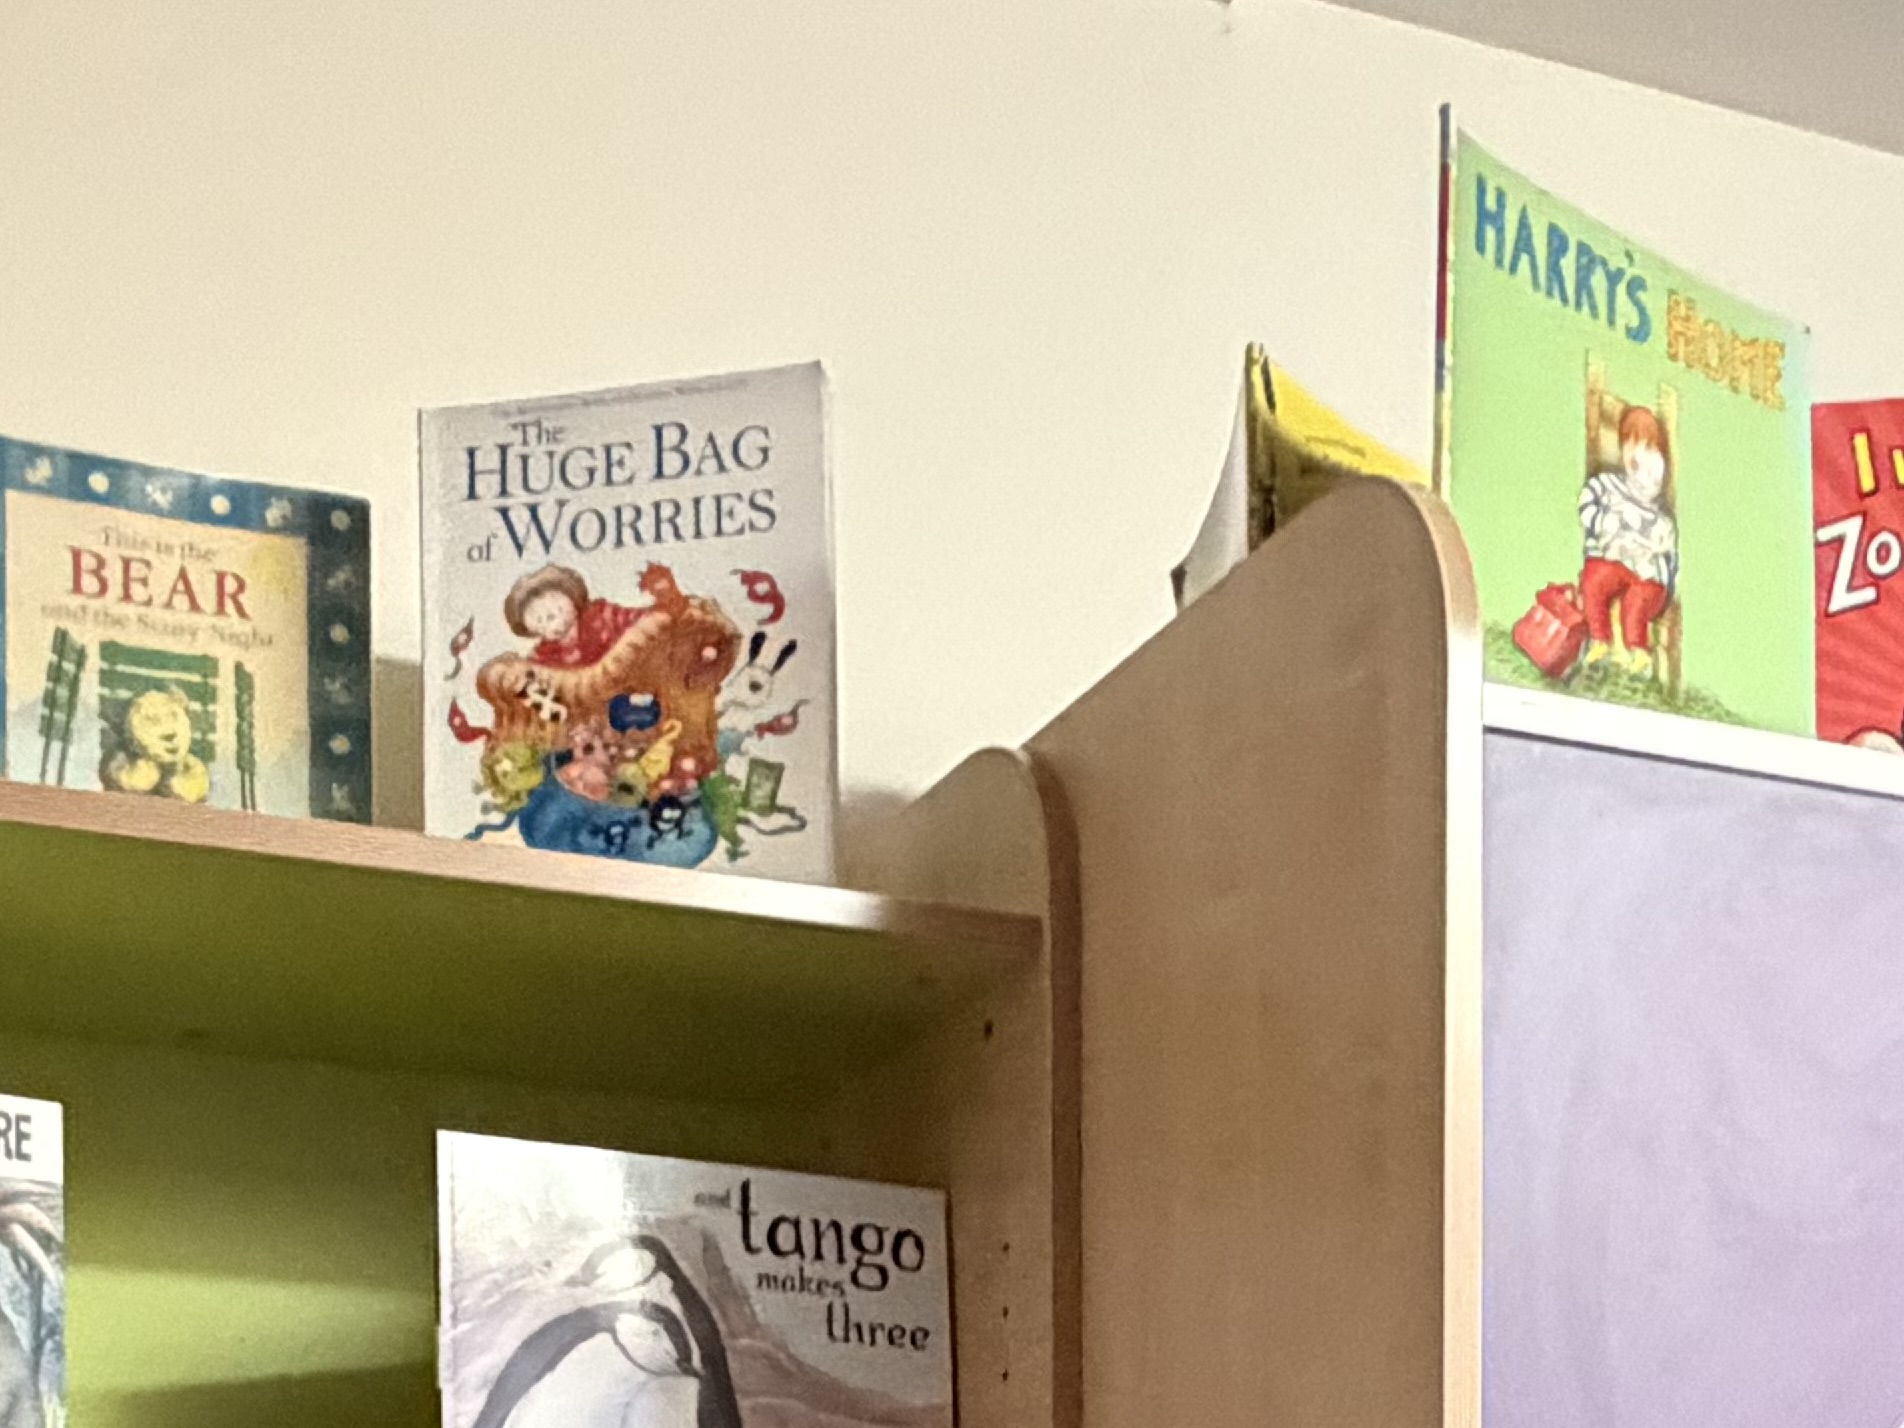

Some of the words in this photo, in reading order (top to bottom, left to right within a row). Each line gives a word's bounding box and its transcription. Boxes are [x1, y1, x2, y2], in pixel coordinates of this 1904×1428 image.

[1475, 172, 1652, 344] HARRY'S
[1666, 288, 1786, 412] HOME
[462, 441, 637, 500] HUGE
[651, 420, 773, 482] BAG
[511, 418, 565, 447] The
[1851, 431, 1879, 498] I
[466, 532, 497, 563] of
[493, 488, 777, 560] WORRIES
[68, 545, 252, 621] BEAR
[737, 1177, 925, 1291] tango
[757, 1266, 846, 1298] makes
[826, 1301, 930, 1350] three
